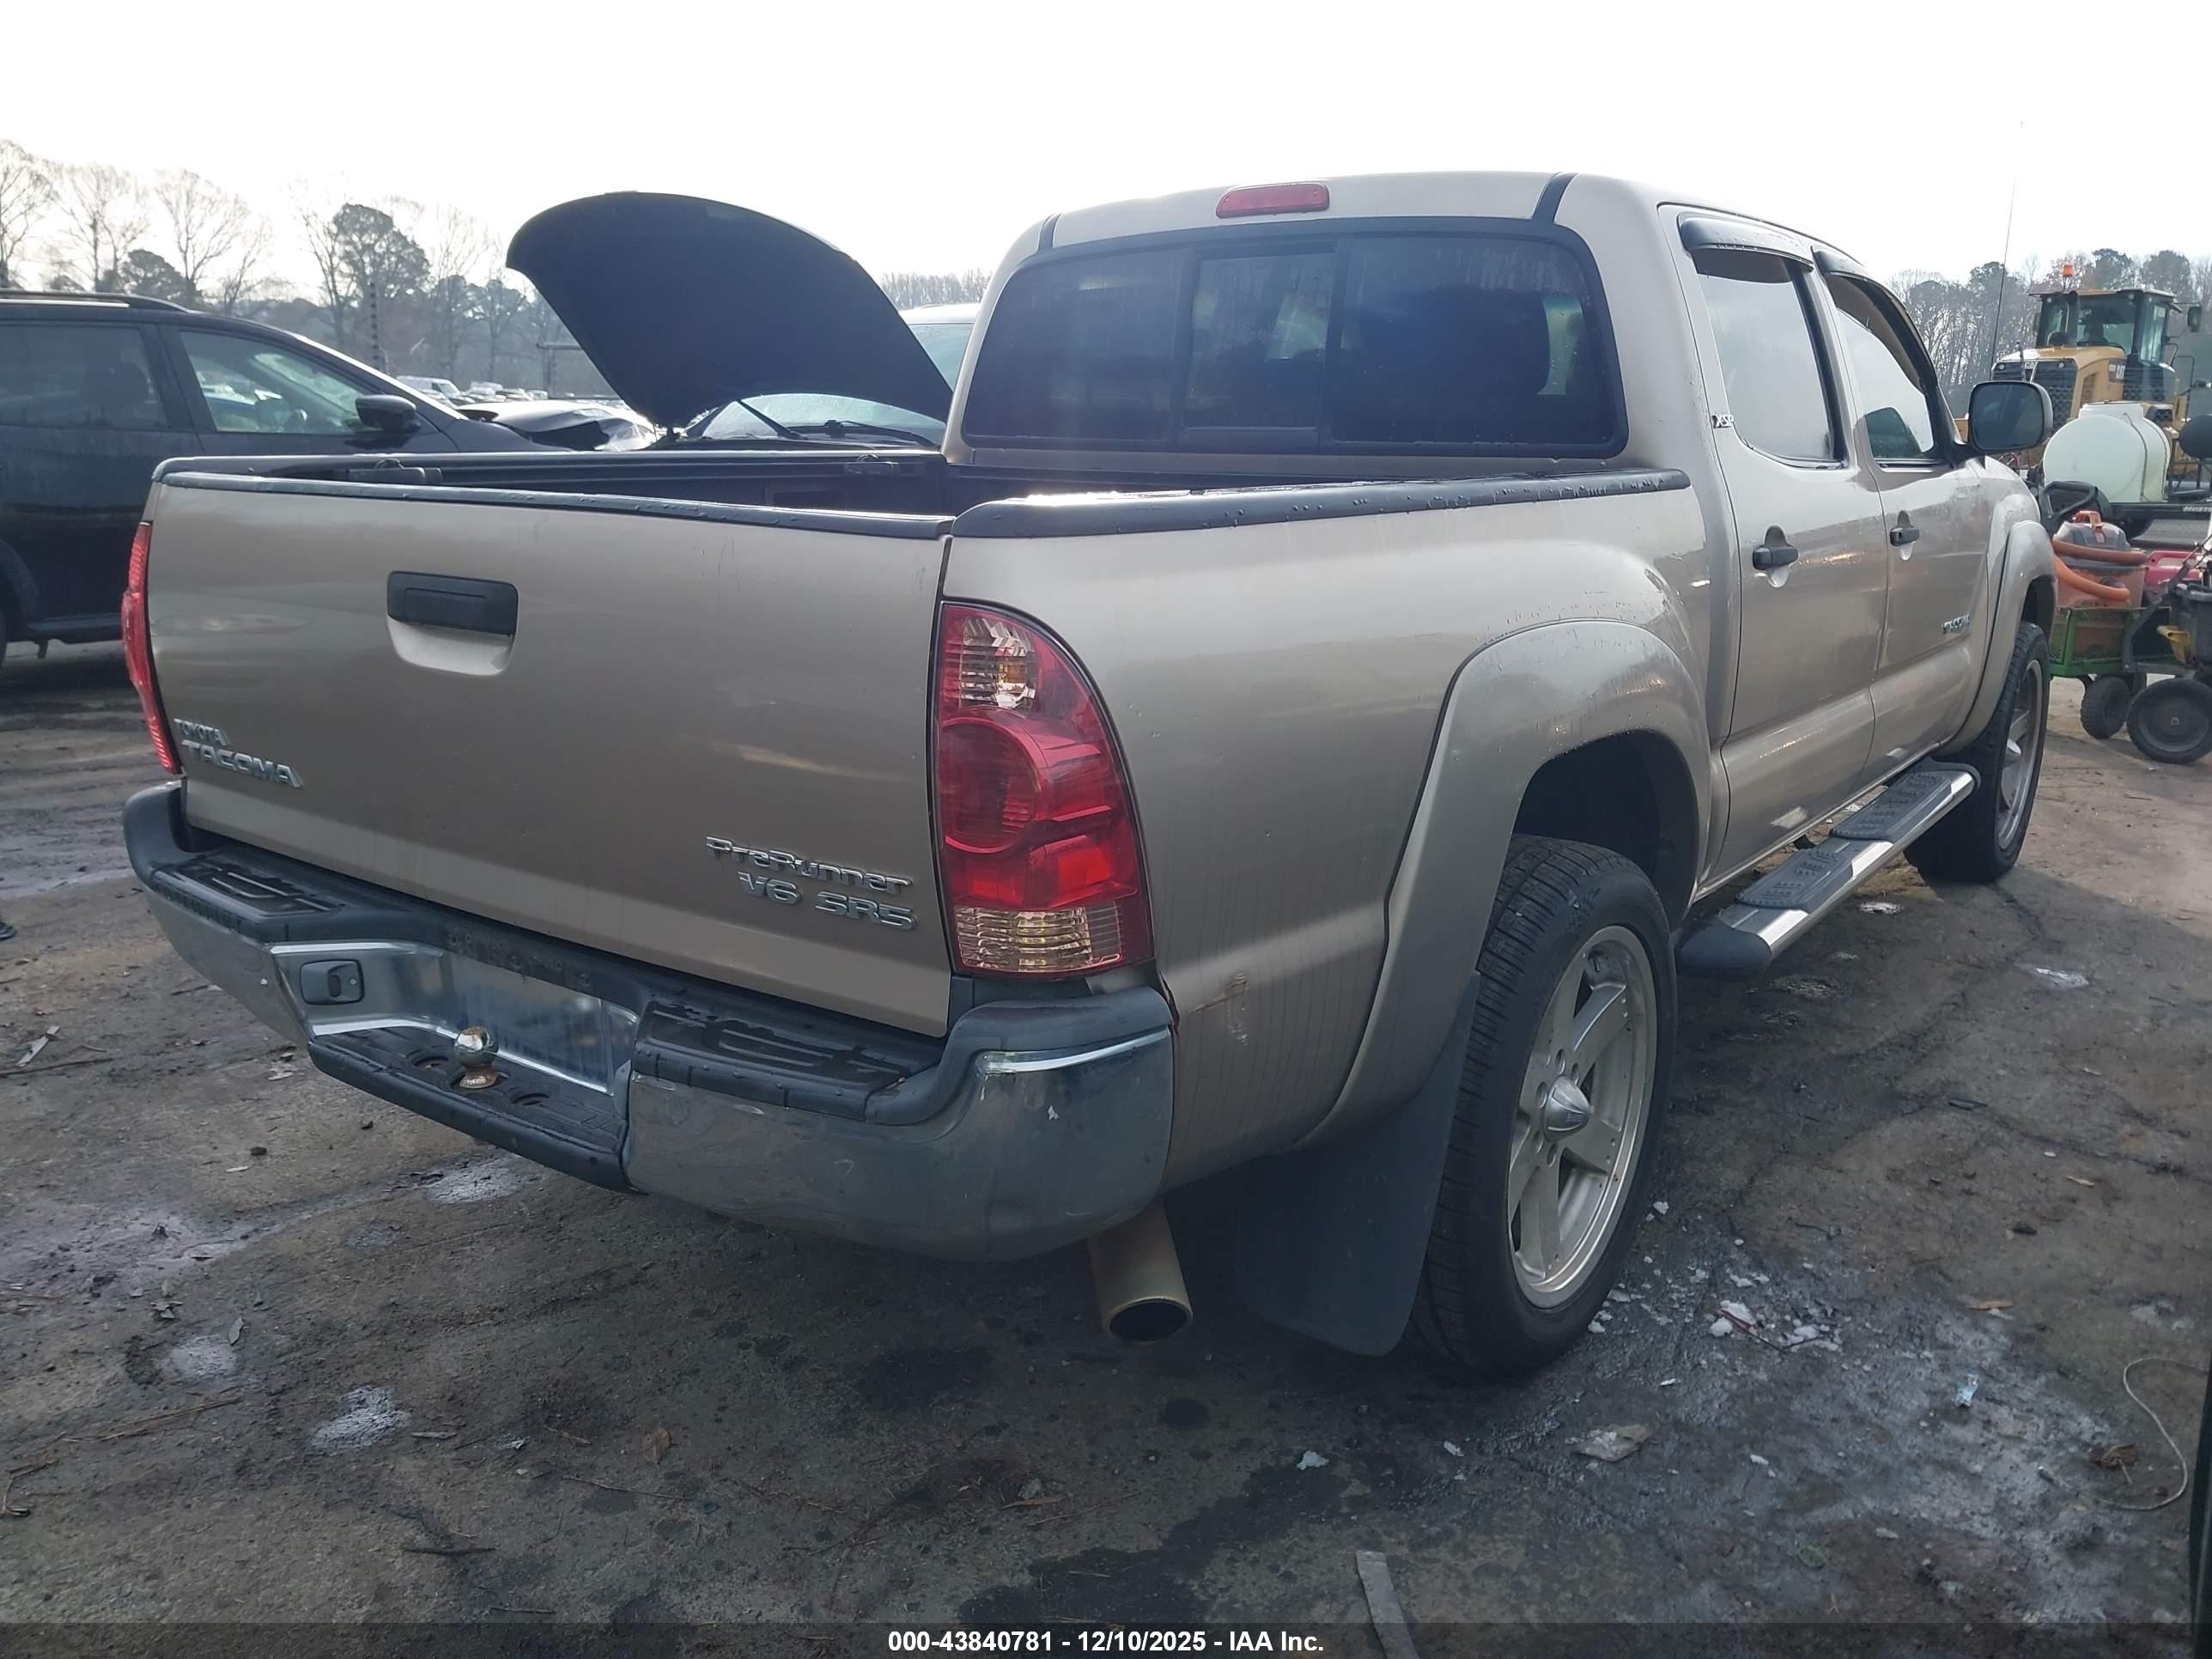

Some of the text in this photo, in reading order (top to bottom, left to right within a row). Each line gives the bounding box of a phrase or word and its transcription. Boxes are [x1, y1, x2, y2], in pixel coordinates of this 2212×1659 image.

[173, 718, 230, 746] TOYOTA
[181, 739, 303, 788] TACOMA
[706, 836, 914, 895] PreRunner
[737, 871, 916, 931] V6 SR5
